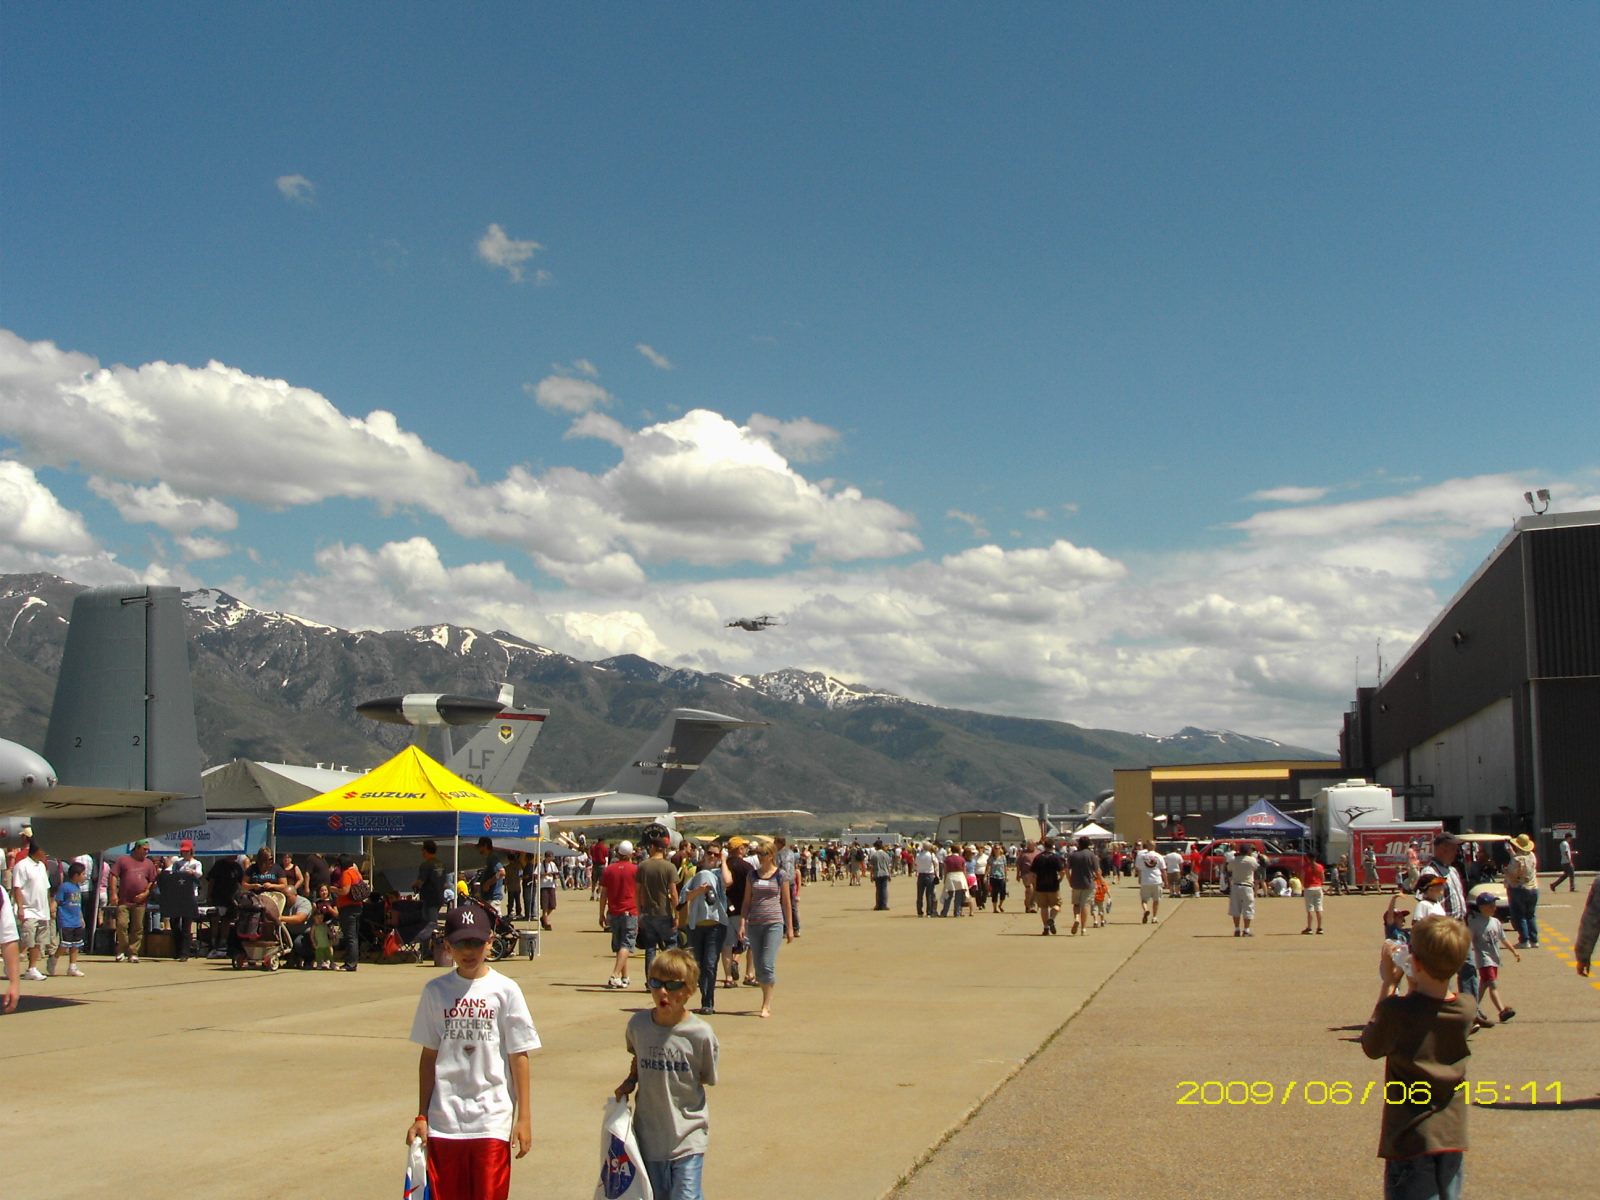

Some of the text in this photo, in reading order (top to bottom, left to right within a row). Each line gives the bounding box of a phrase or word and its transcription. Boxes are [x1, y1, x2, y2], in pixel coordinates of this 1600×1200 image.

[74, 736, 82, 748] 2
[132, 735, 141, 747] 2
[468, 748, 495, 769] LF
[360, 791, 427, 799] SUZUKI
[344, 815, 404, 828] SUZUKI
[455, 997, 487, 1009] FANS
[443, 1007, 496, 1020] LOVE ME
[444, 1019, 493, 1030] PITCHERS
[443, 1029, 474, 1041] FEAR
[640, 1058, 690, 1072] CHESSER
